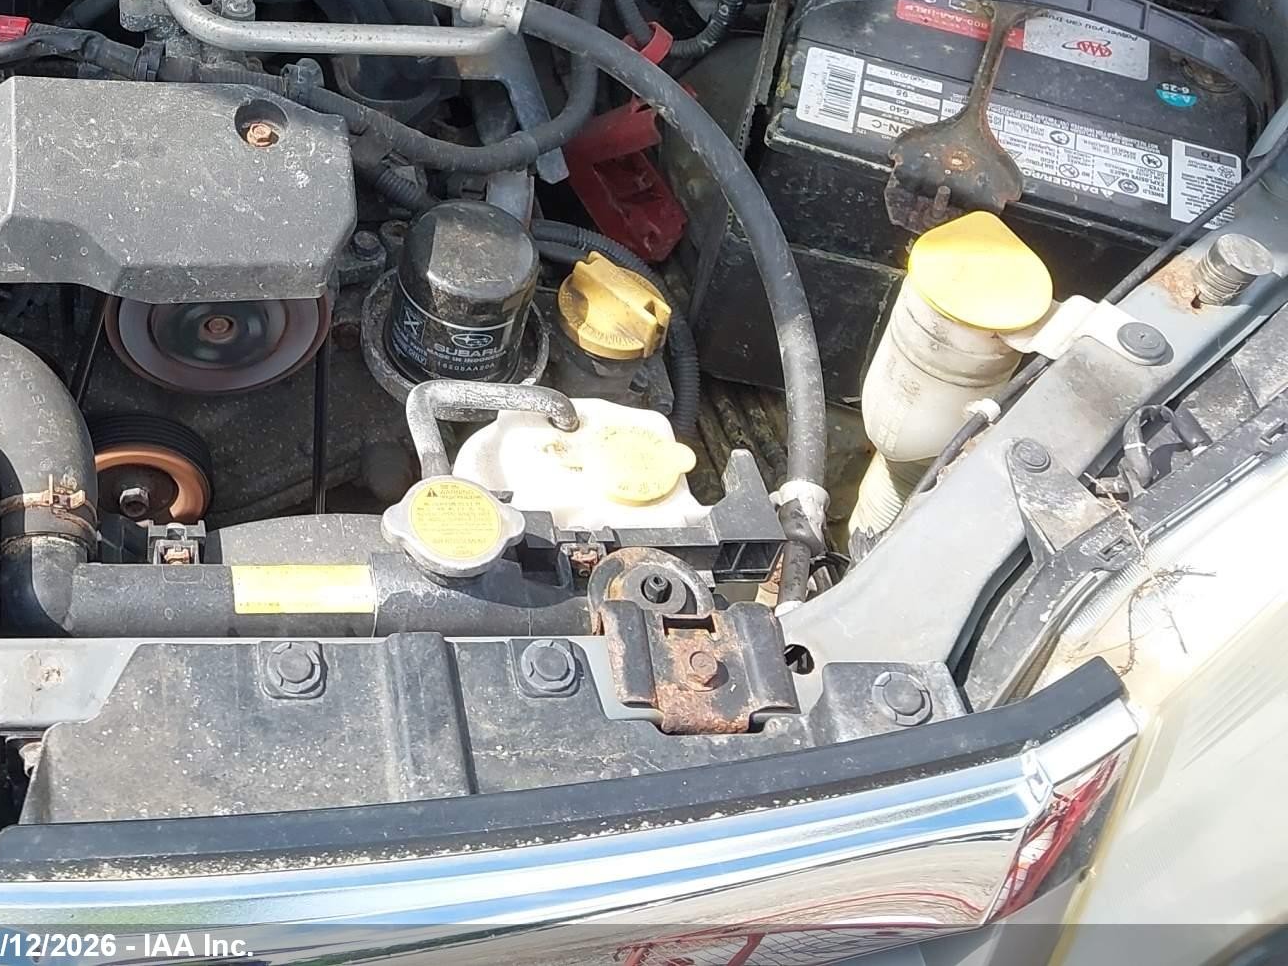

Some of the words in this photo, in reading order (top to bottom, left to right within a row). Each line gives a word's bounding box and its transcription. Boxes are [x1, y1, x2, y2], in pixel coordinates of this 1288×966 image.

[1085, 23, 1104, 32] you
[1108, 30, 1138, 41] Power
[1078, 40, 1111, 57] AAA
[1161, 82, 1190, 94] 6-25
[889, 106, 910, 115] 640
[434, 343, 504, 358] SUBARU
